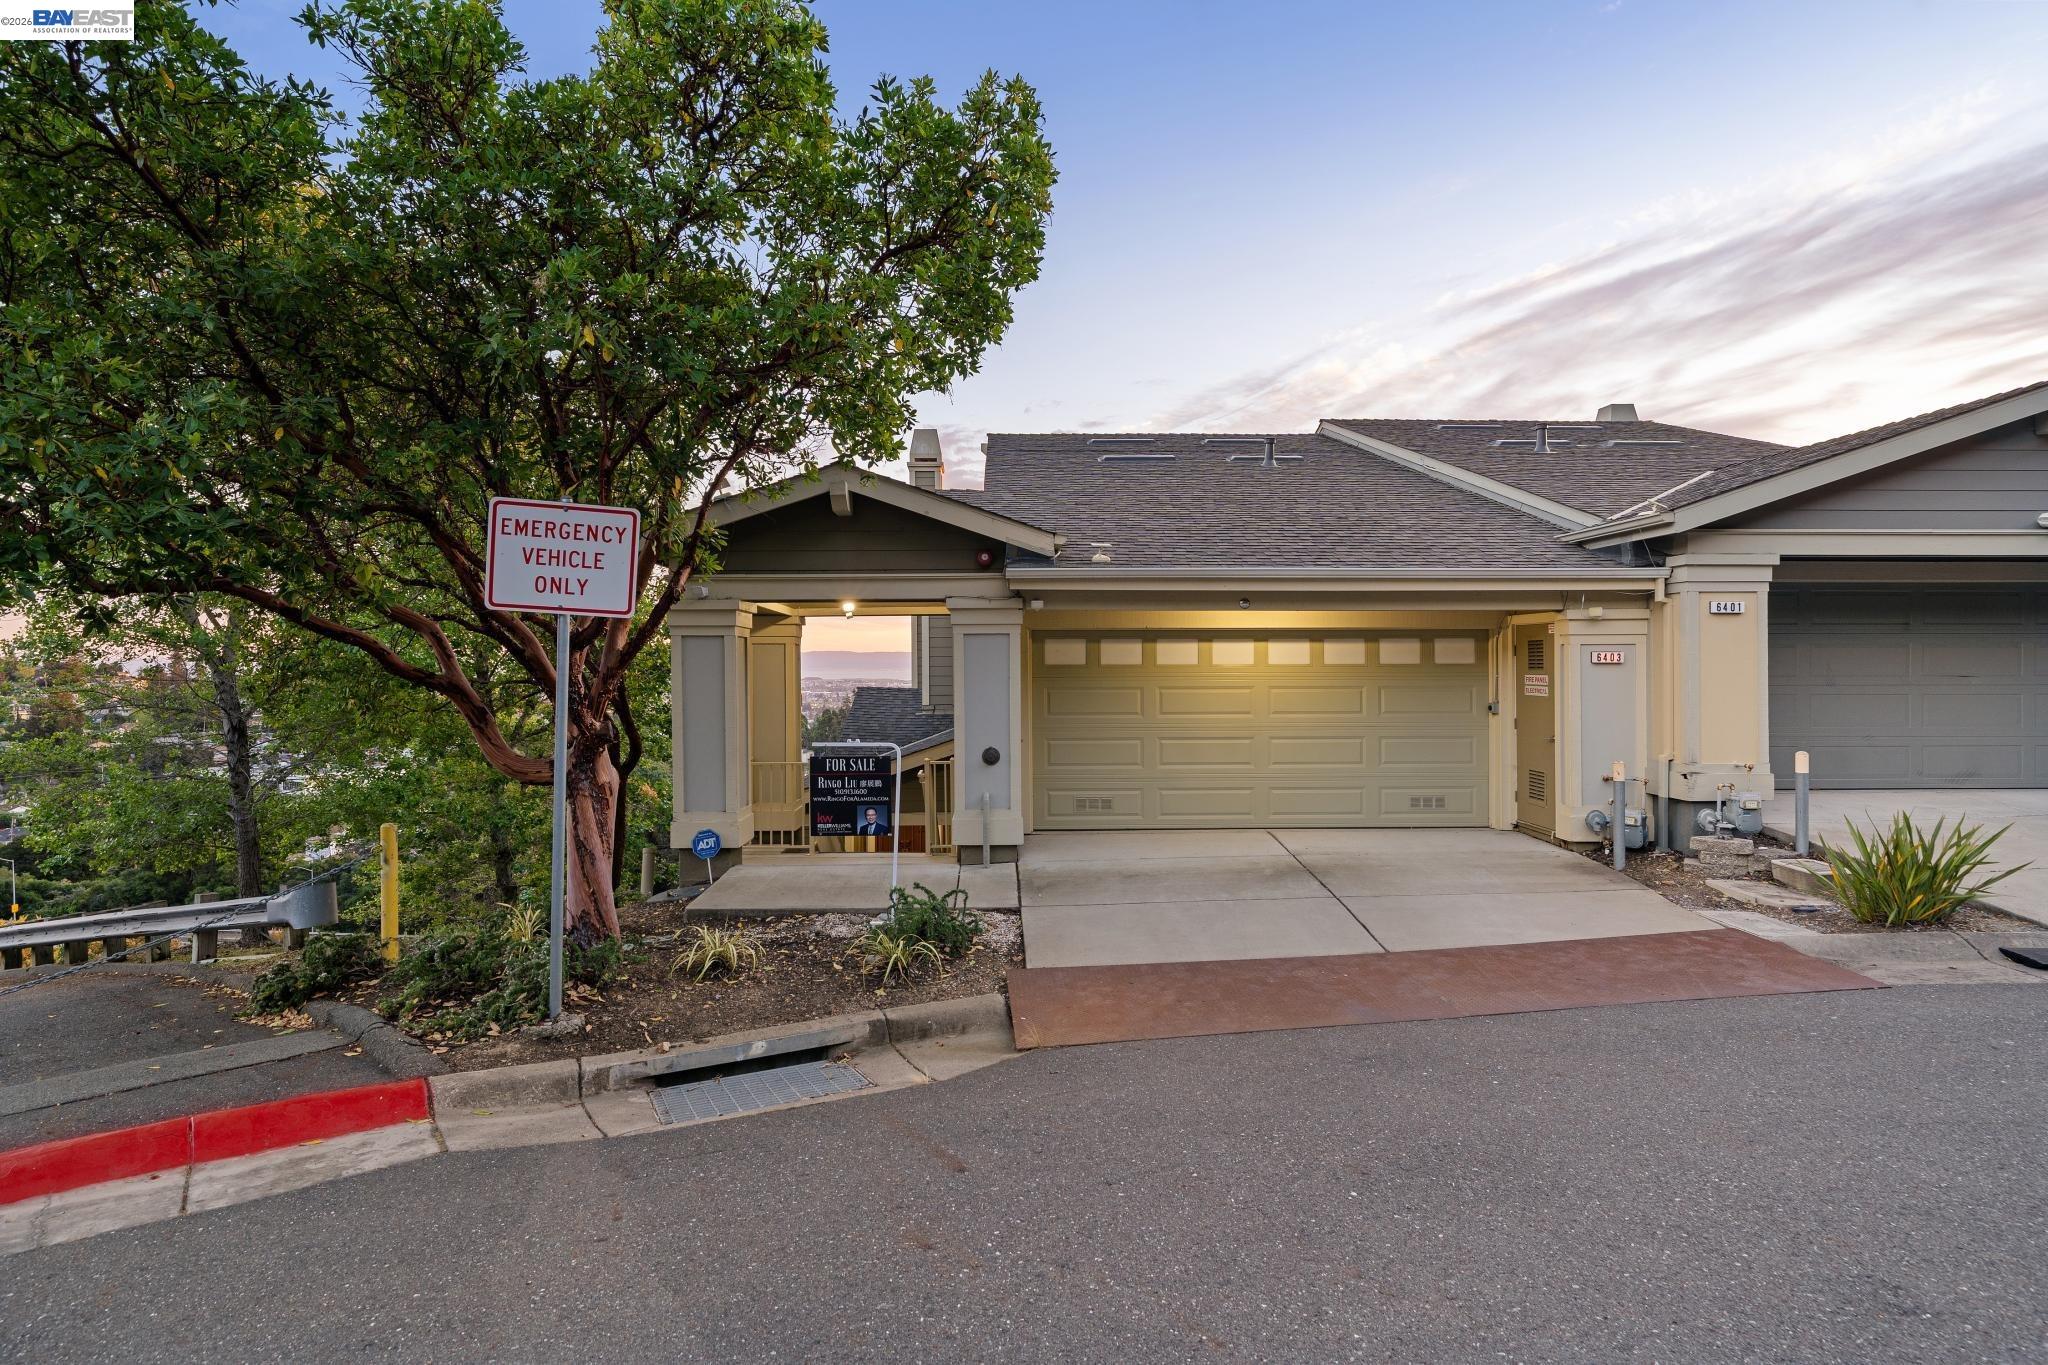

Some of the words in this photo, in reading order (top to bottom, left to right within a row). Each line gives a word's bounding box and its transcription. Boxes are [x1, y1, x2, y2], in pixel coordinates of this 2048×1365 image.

[501, 517, 627, 544] EMERGENCY
[522, 547, 605, 569] VEHICLE
[535, 575, 589, 596] ONLY
[1716, 602, 1741, 612] 6401
[1596, 653, 1622, 662] 6403
[1534, 676, 1548, 684] PANEL
[826, 758, 846, 771] FOR
[849, 758, 876, 771] SALE
[817, 811, 833, 823] kw
[698, 837, 716, 849] ADT
